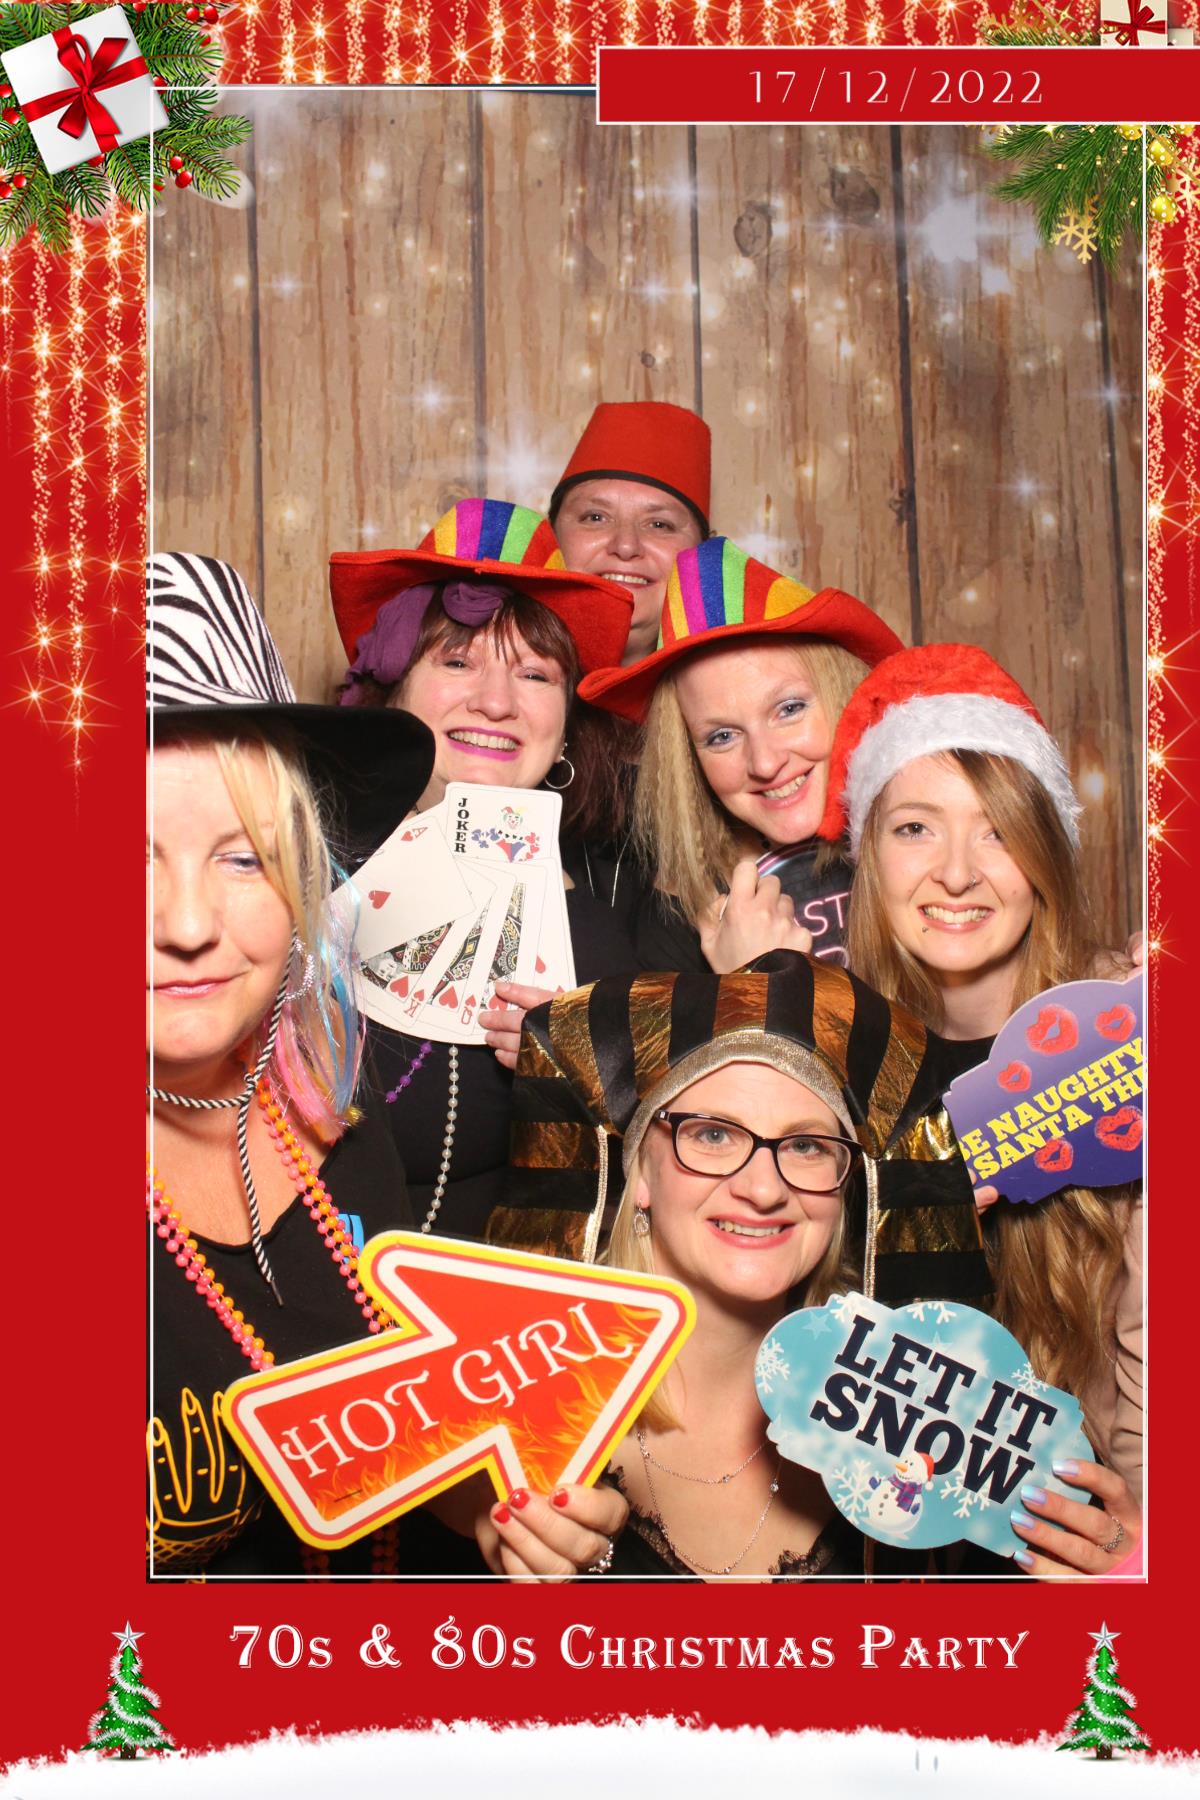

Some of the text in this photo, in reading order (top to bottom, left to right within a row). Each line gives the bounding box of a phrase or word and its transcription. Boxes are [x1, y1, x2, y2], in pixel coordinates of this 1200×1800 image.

[412, 826, 429, 839] A
[454, 797, 470, 854] JOKER
[403, 999, 421, 1018] K
[461, 1006, 473, 1025] Q
[986, 1036, 1146, 1143] NAUGHTY
[973, 1103, 1094, 1180] SANTA
[280, 1302, 634, 1478] HOT GIRL
[834, 1314, 1059, 1453] LET IT
[809, 1372, 1036, 1505] SNOW
